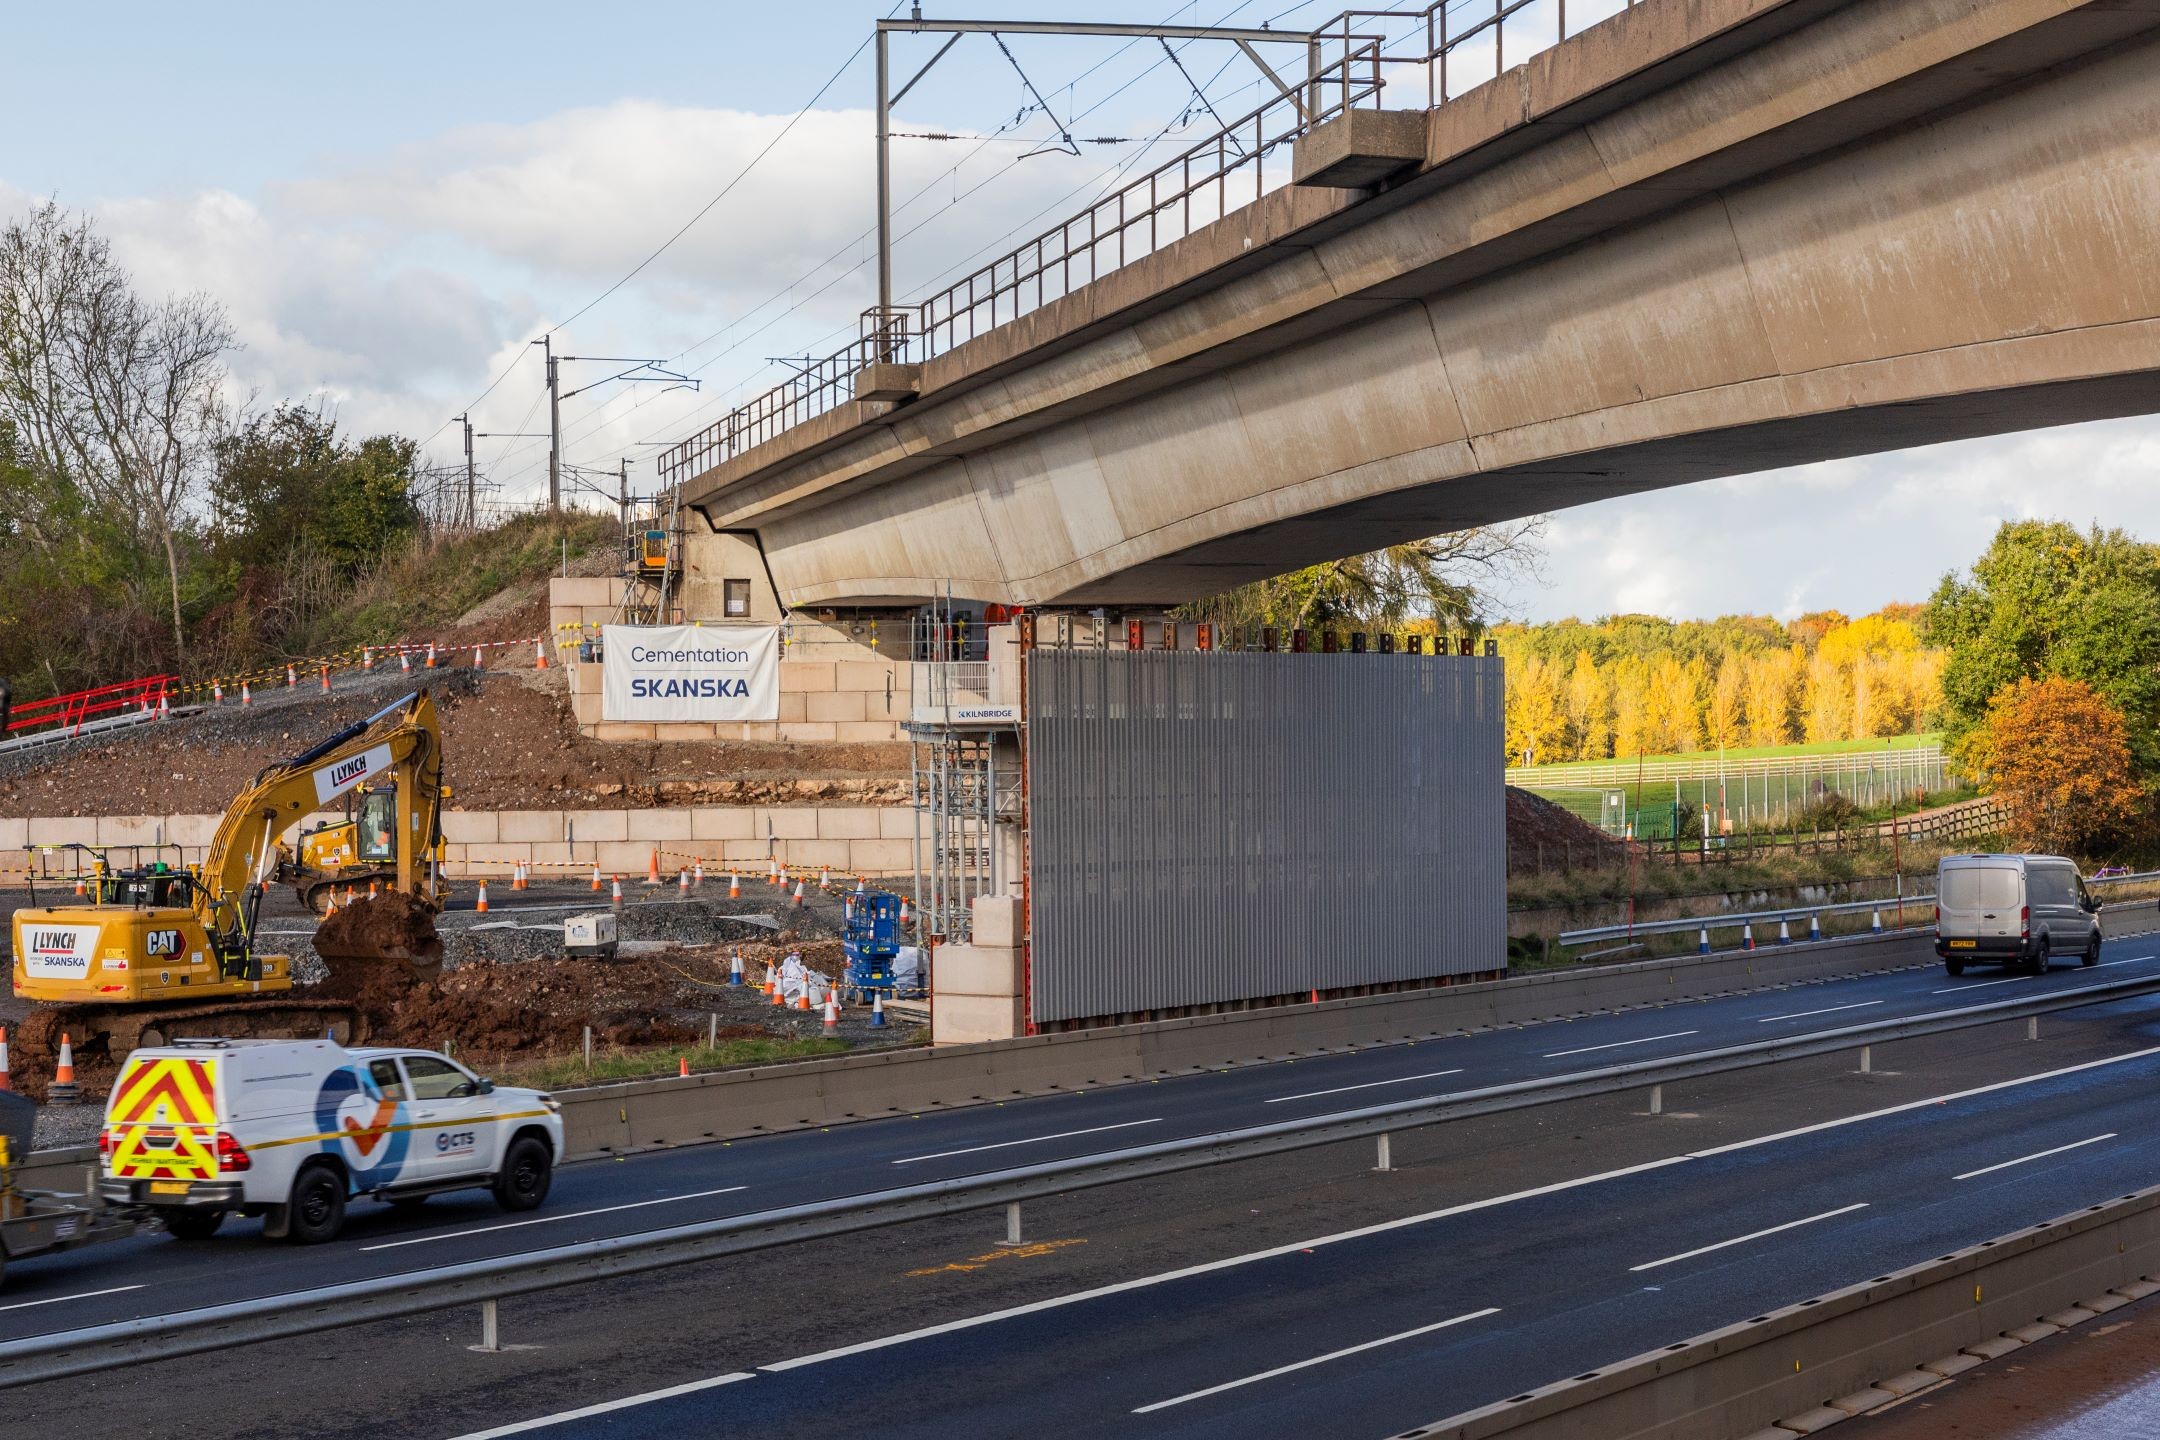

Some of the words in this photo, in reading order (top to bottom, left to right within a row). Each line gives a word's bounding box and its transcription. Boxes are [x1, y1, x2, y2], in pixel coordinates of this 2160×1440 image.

[631, 646, 749, 663] Cementation
[631, 678, 750, 698] SKANSKA
[965, 710, 1012, 718] KILNBRIDGE
[147, 930, 177, 955] CAT
[44, 956, 85, 967] SKANSKA
[450, 1131, 475, 1146] CTS
